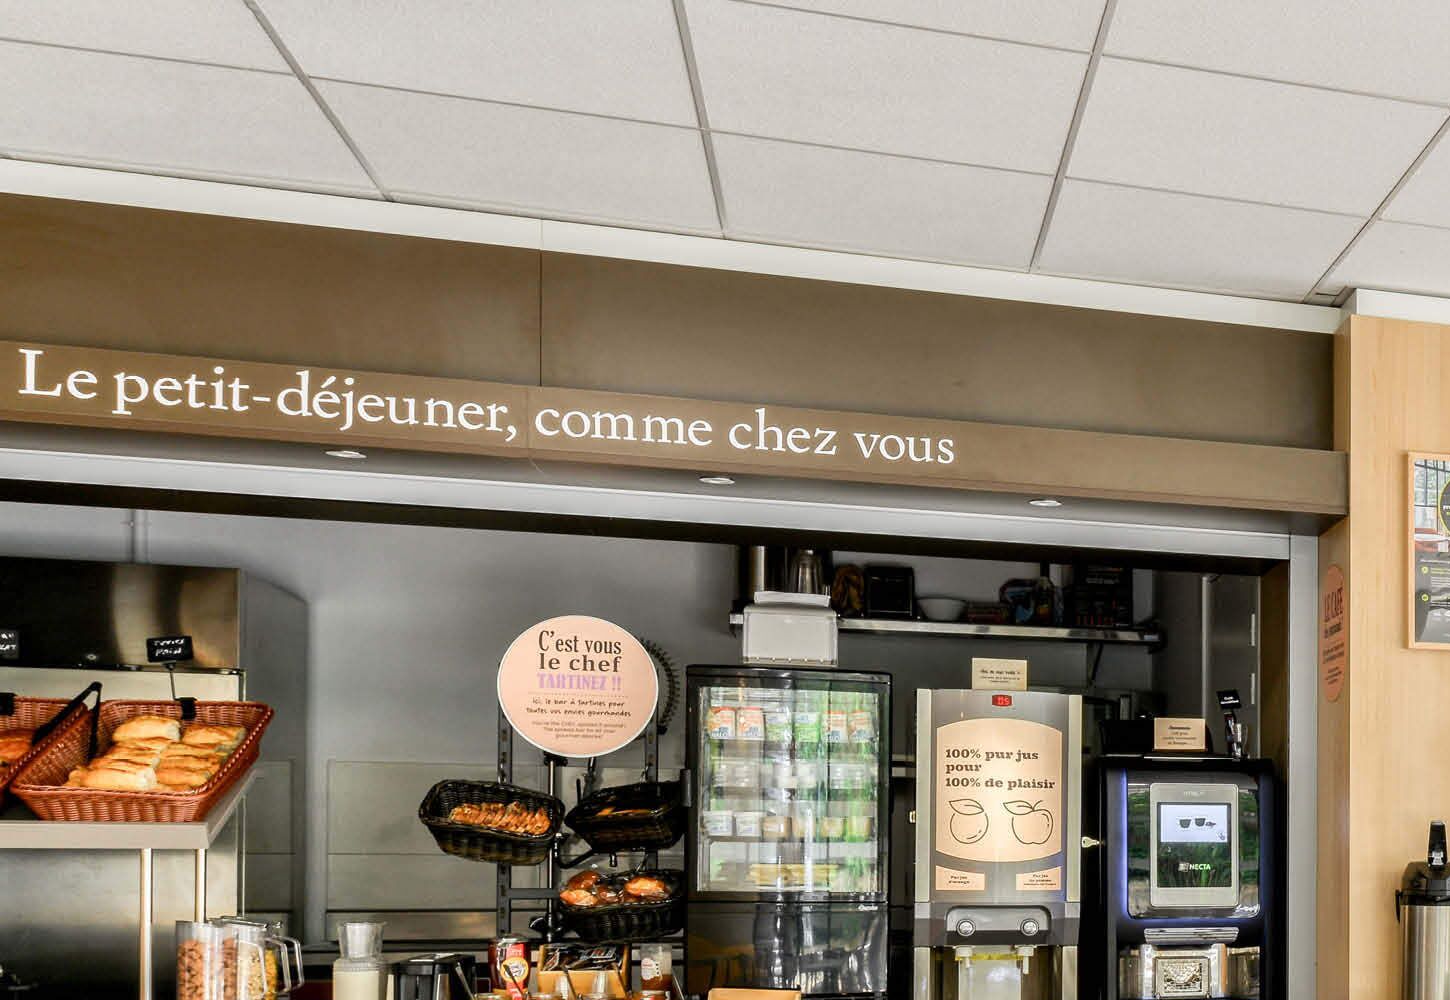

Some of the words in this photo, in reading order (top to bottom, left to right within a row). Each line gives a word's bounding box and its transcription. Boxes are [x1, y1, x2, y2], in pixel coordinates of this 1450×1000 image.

[19, 347, 98, 399] Le
[111, 366, 517, 443] petit-déjeuner,
[534, 408, 713, 447] comme
[728, 407, 837, 456] chez
[853, 432, 955, 465] vous
[538, 630, 580, 653] C'est
[584, 640, 622, 655] vous
[539, 653, 560, 670] le
[569, 655, 622, 673] chef
[537, 672, 607, 691] TARTINEZ
[588, 710, 631, 718] gourmandes
[945, 748, 981, 759] 100%
[985, 751, 1013, 761] pur
[1015, 749, 1039, 762] jus
[945, 764, 982, 774] pour
[945, 777, 981, 788] 100%
[984, 778, 1003, 788] de
[1008, 778, 1056, 790] plaisir
